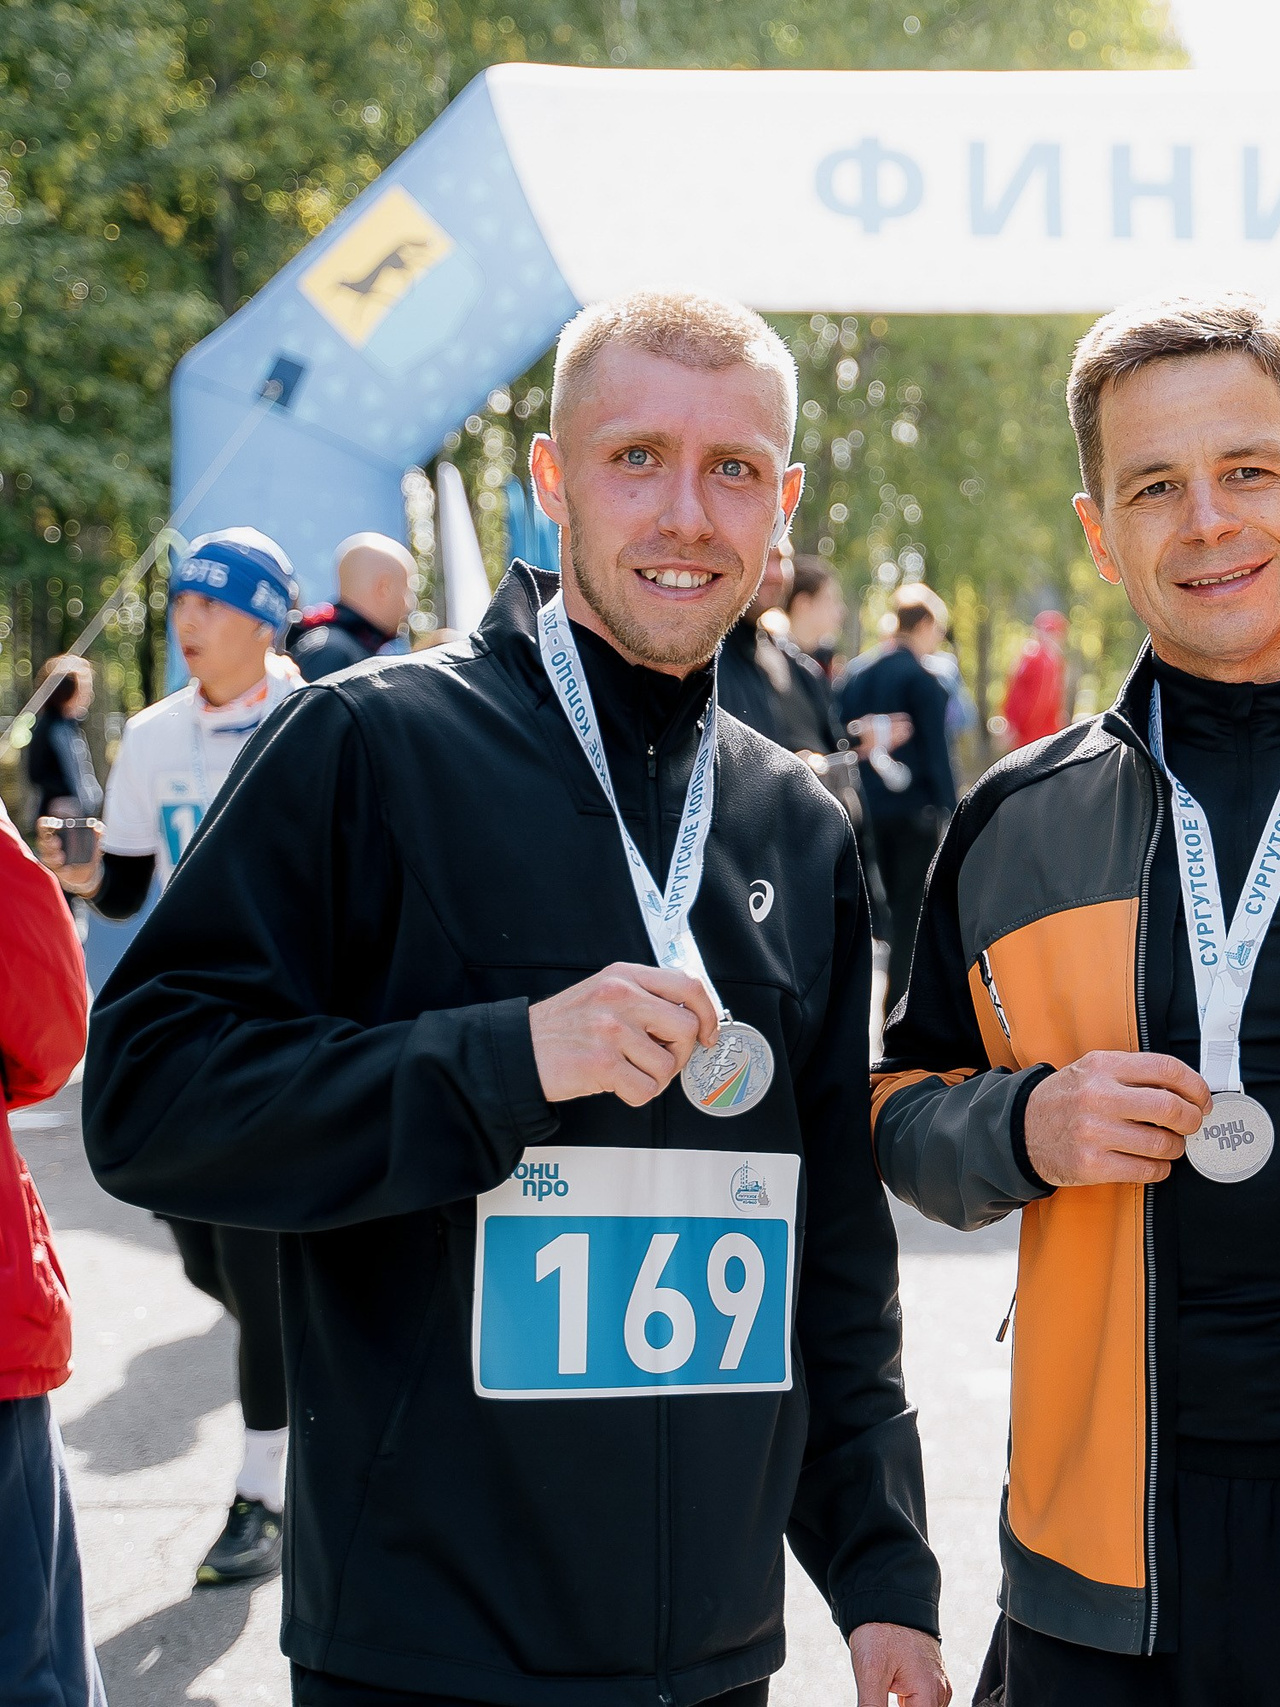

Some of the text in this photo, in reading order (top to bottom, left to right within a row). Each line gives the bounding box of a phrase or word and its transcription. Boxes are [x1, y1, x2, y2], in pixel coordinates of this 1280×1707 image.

[551, 651, 591, 737] КОЛЬЦО
[664, 820, 699, 921] СУРГУТСКОЕ
[687, 748, 710, 818] КОЛЬЦО
[1182, 819, 1218, 966] СУРГУТСКОЕ
[536, 1232, 765, 1374] 169
